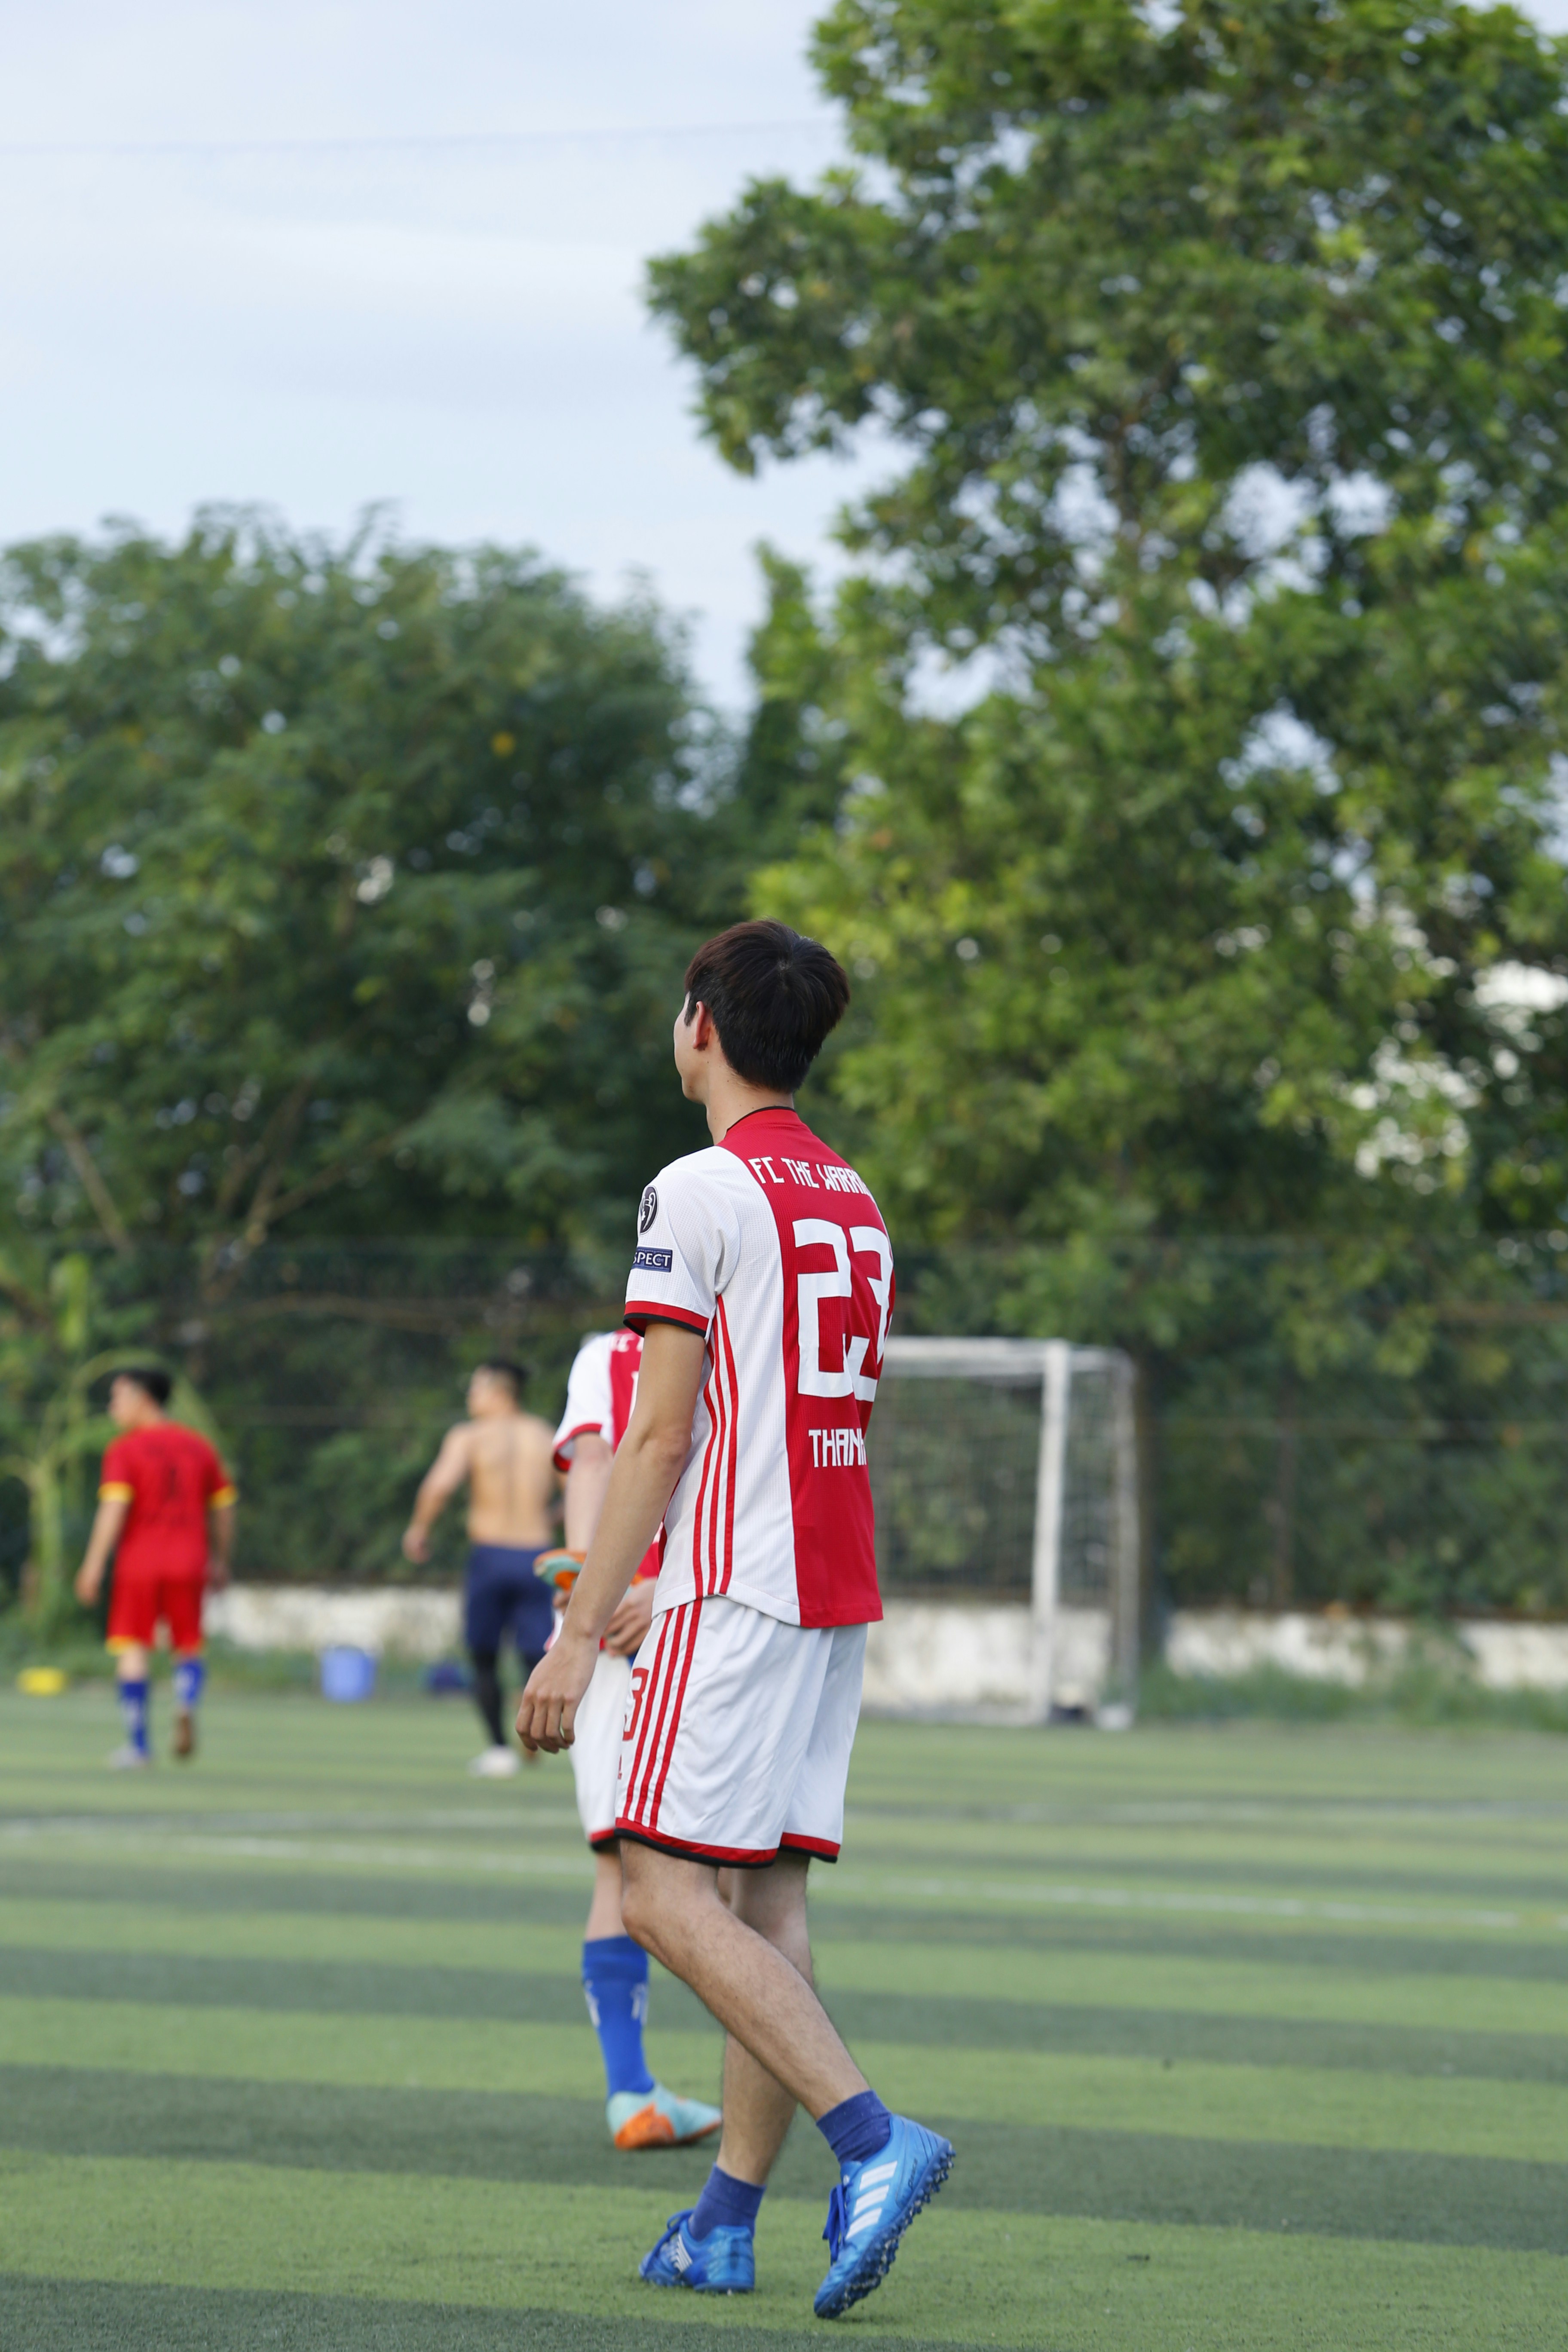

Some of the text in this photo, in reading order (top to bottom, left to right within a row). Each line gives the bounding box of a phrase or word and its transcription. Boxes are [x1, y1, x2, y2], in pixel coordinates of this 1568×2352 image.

[748, 1156, 784, 1184] FC
[780, 1157, 820, 1188] THE
[792, 1218, 894, 1402] 23
